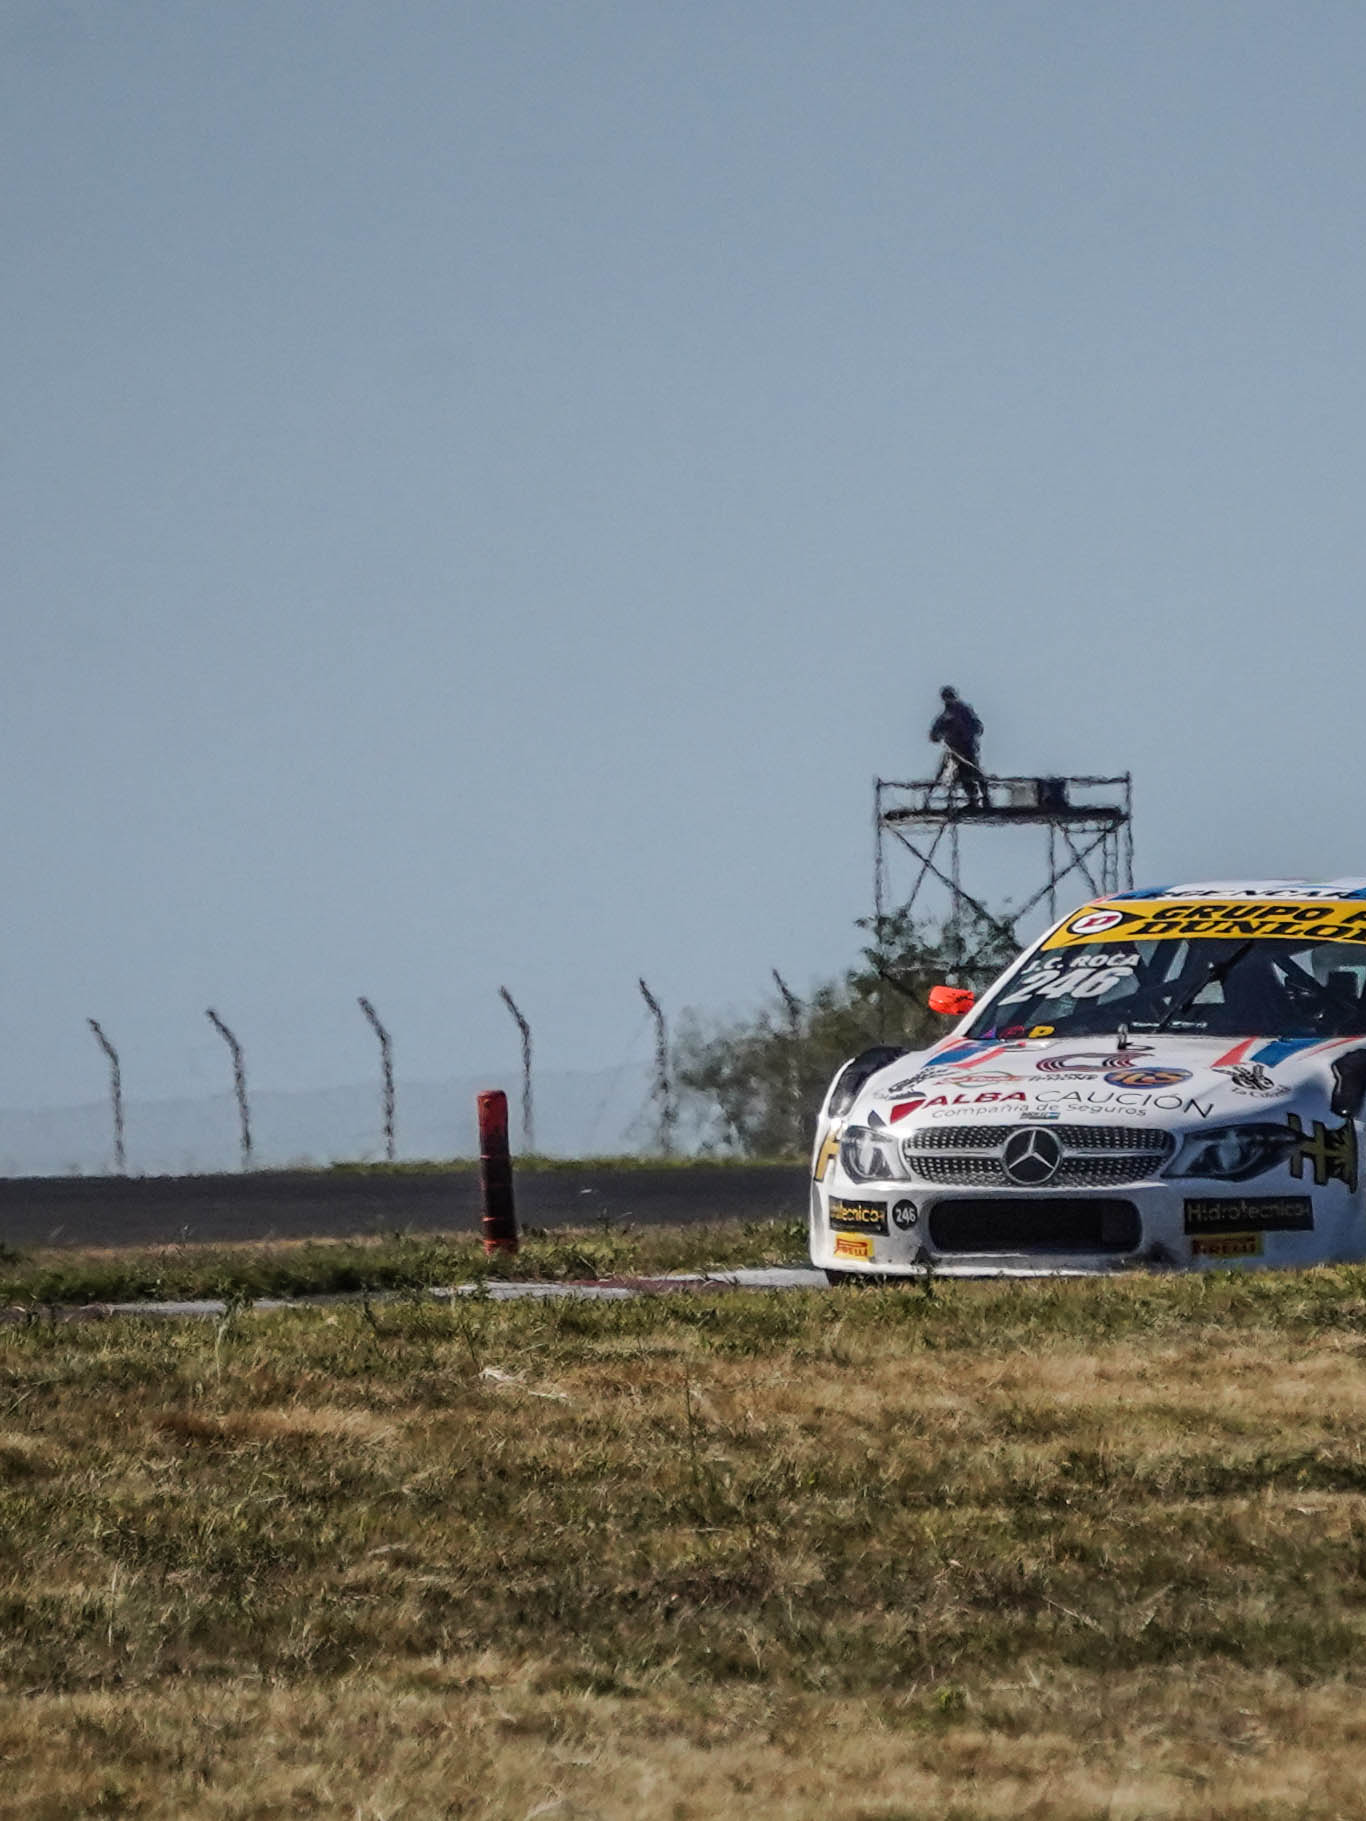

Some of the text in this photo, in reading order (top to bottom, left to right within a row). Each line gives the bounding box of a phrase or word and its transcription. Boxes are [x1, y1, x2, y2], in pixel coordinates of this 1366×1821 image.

[1151, 904, 1336, 921] GRUPO
[1070, 953, 1141, 968] ROCA
[997, 966, 1134, 1006] 246
[922, 1090, 1215, 1119] ALBA CAUCIÓN
[1036, 1102, 1060, 1113] de
[895, 1207, 916, 1225] 246
